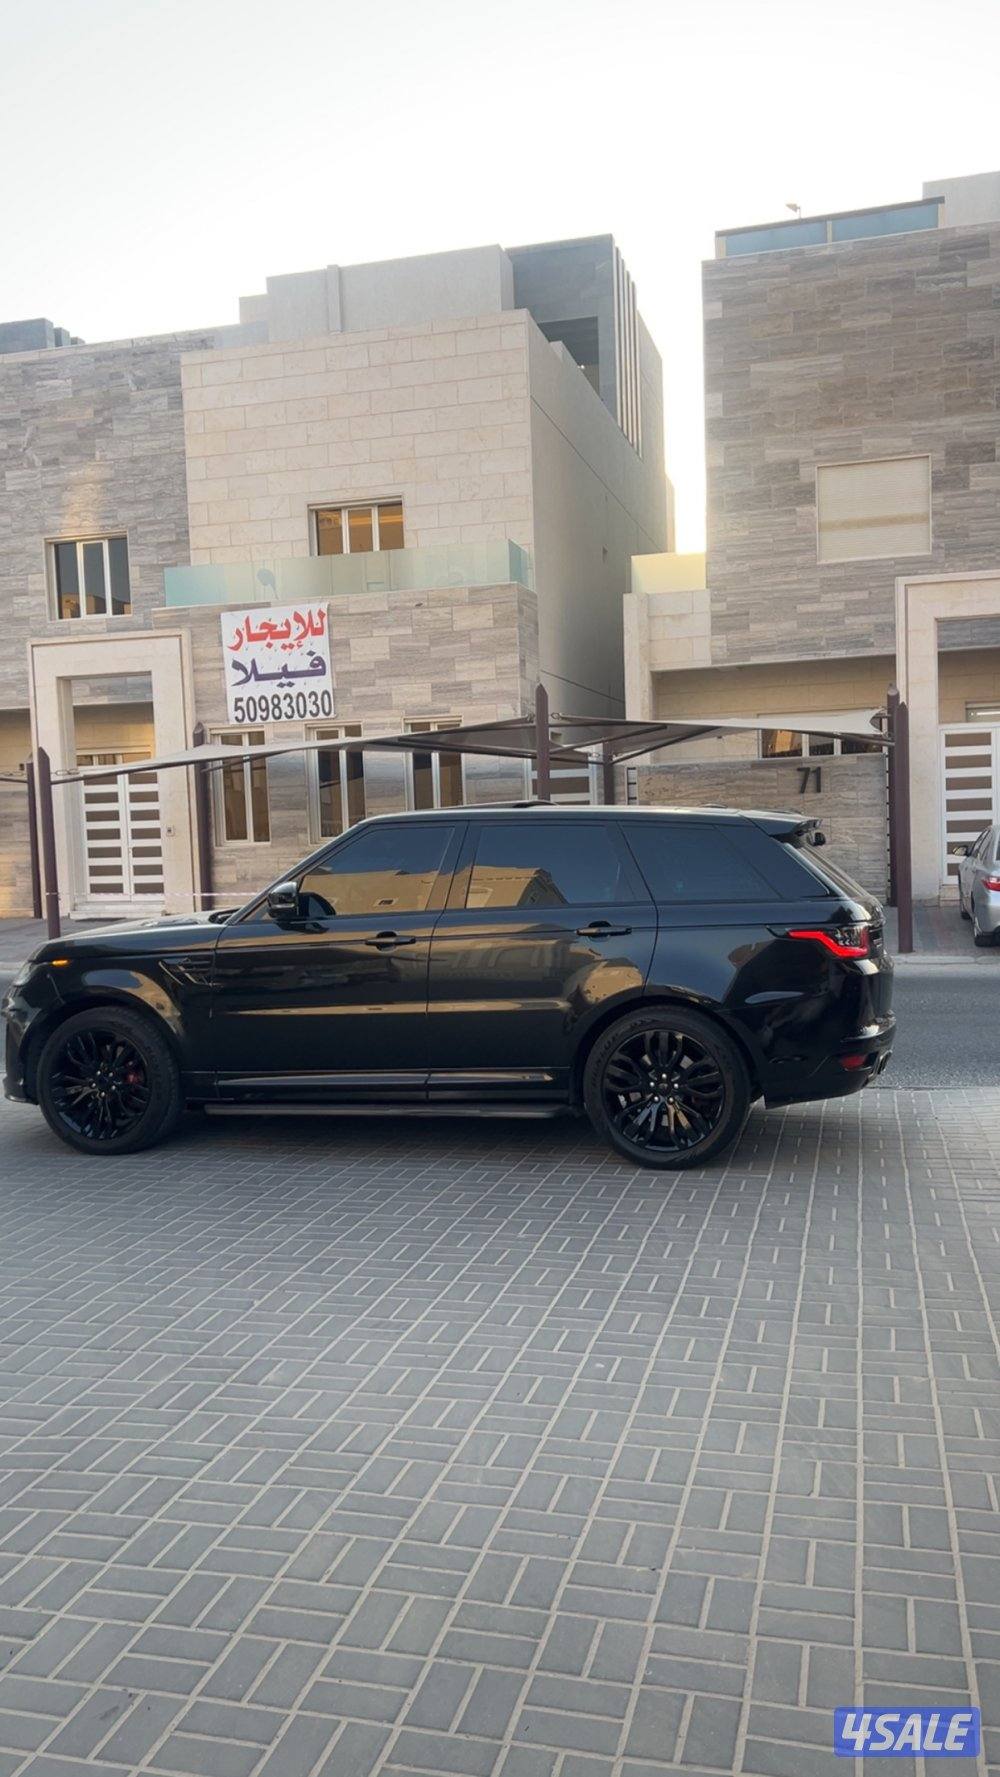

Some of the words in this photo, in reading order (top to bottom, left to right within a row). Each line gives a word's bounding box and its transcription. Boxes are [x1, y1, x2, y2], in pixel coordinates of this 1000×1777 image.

[227, 608, 326, 651] للإيجار
[231, 650, 326, 688] فيلا
[234, 689, 332, 723] 50983030
[797, 766, 822, 794] 71
